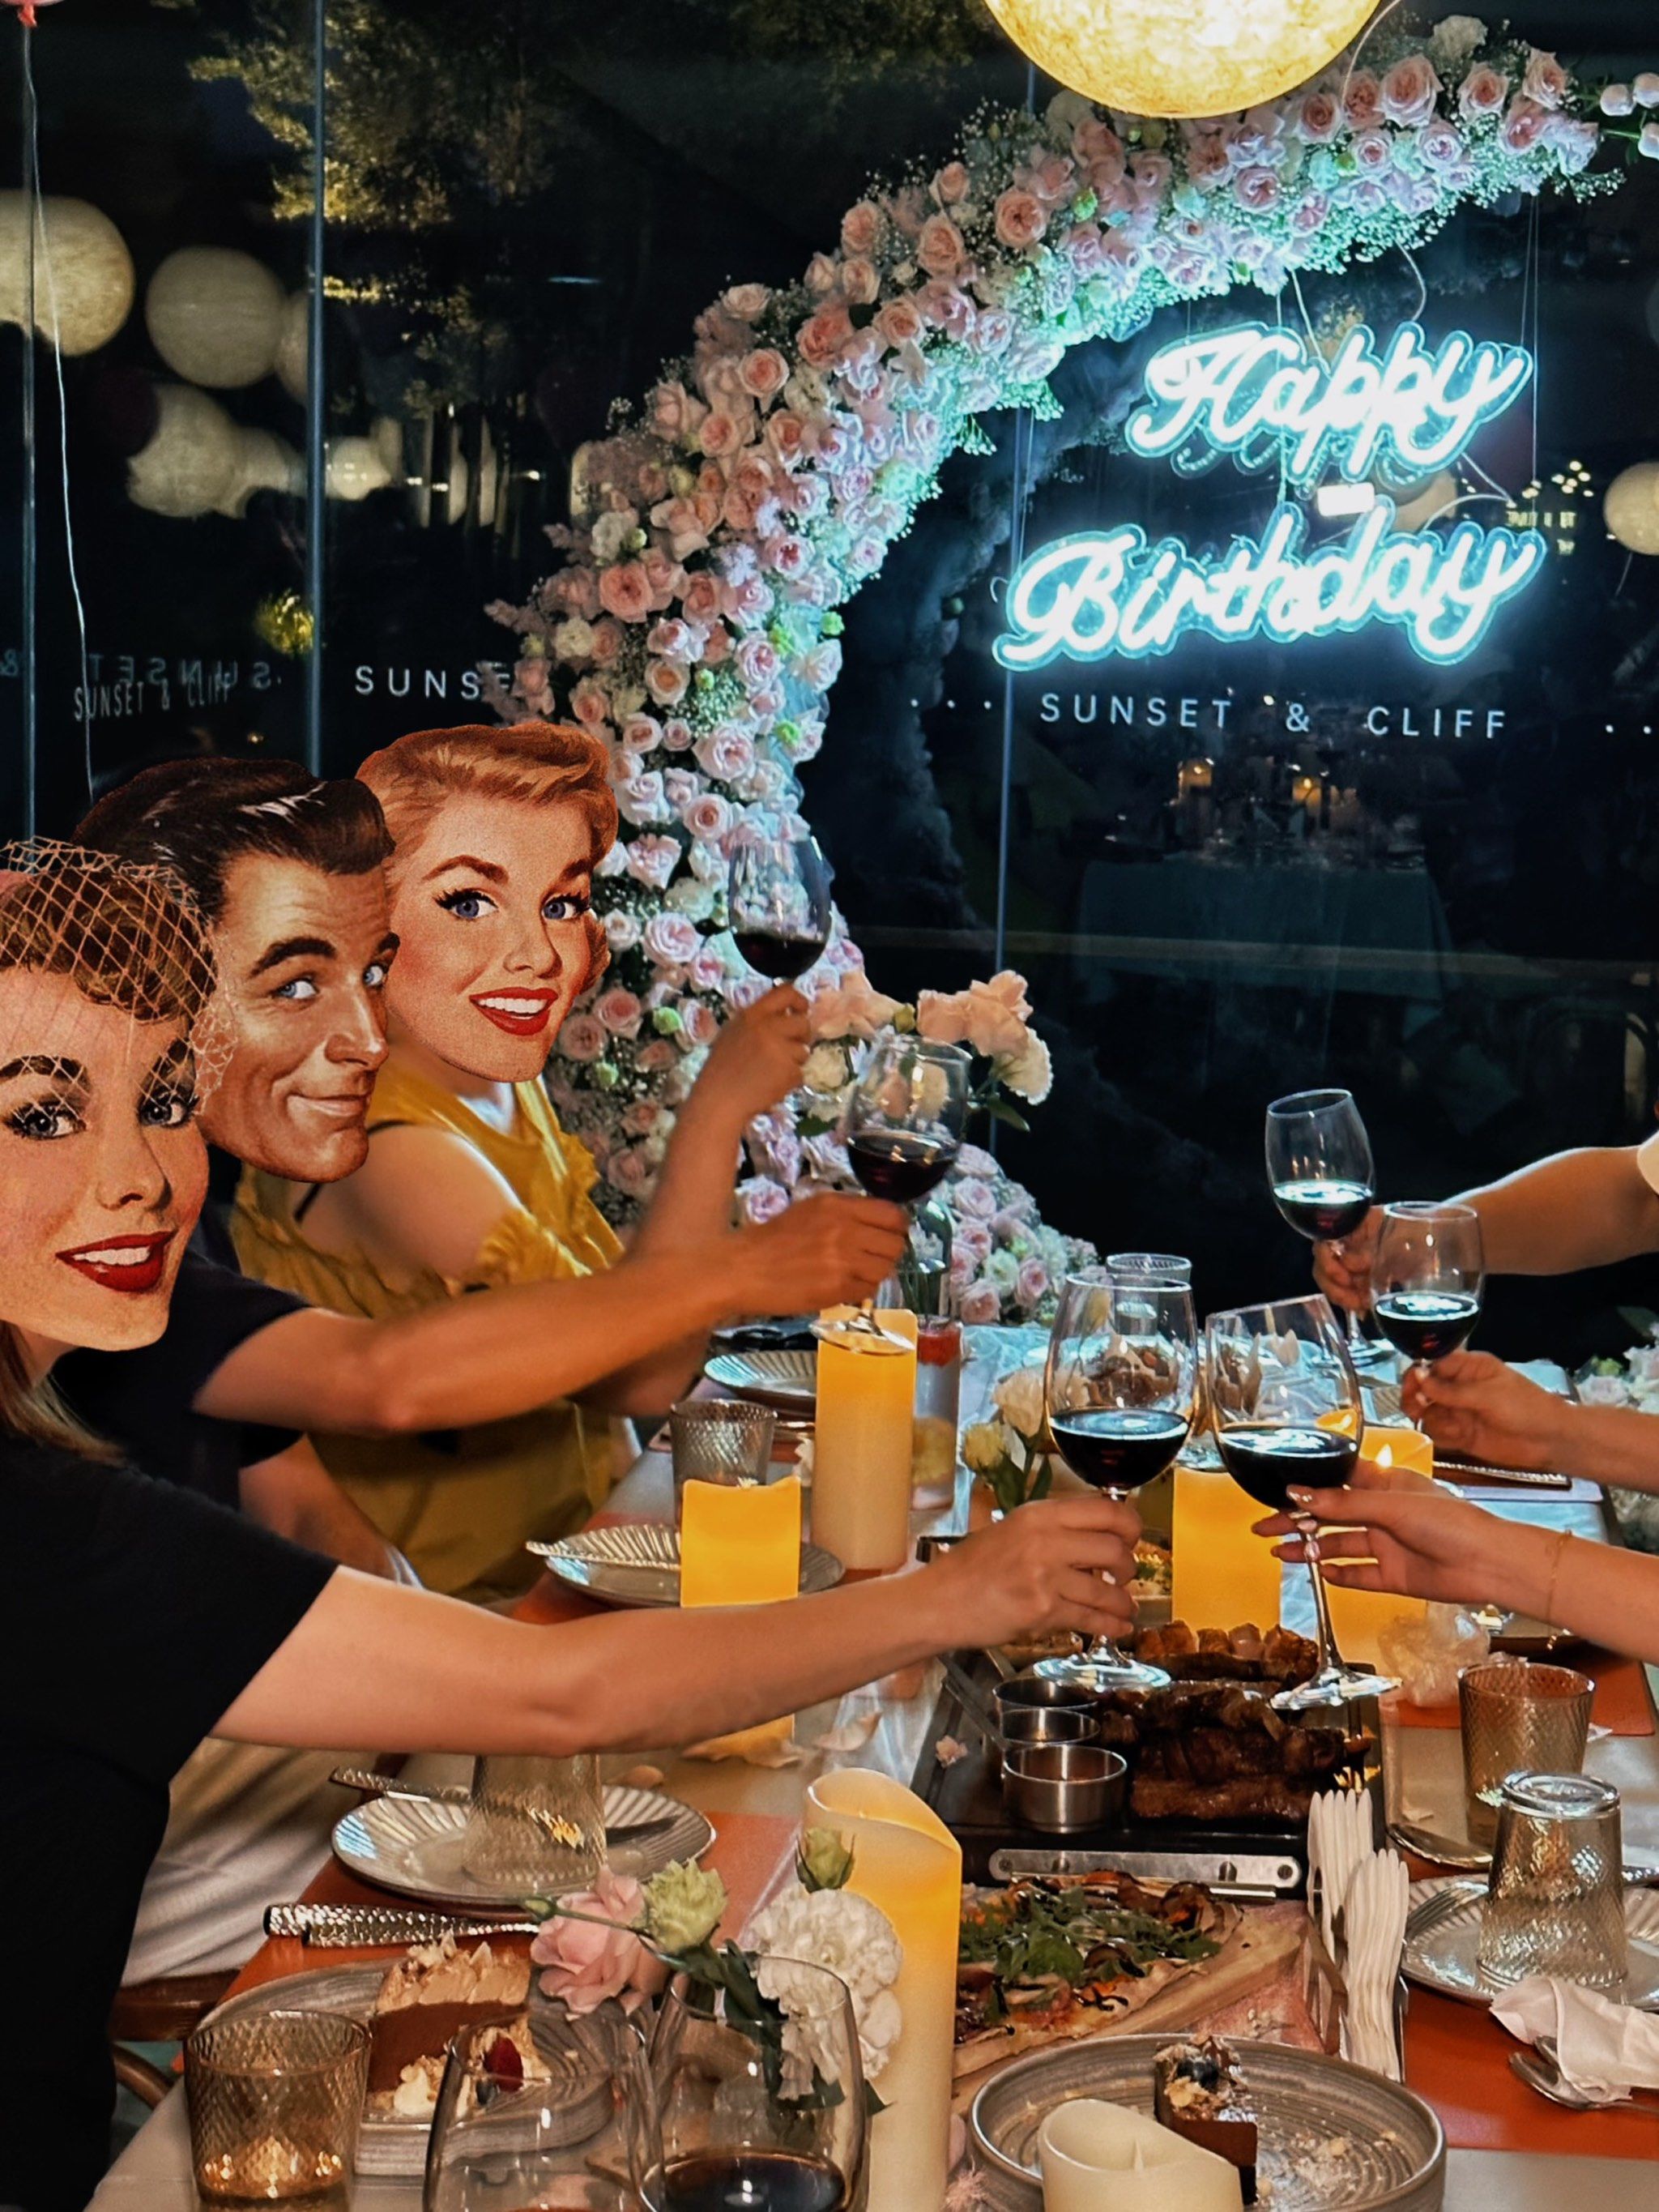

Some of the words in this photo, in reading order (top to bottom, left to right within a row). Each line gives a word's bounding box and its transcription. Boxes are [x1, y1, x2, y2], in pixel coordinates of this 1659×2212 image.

[1127, 325, 1531, 481] Happy
[994, 500, 1544, 668] Birthday
[73, 680, 146, 723] SUNSET
[1040, 693, 1231, 728] SUNSET
[1286, 703, 1310, 732] &
[1367, 707, 1507, 738] CLIFF
